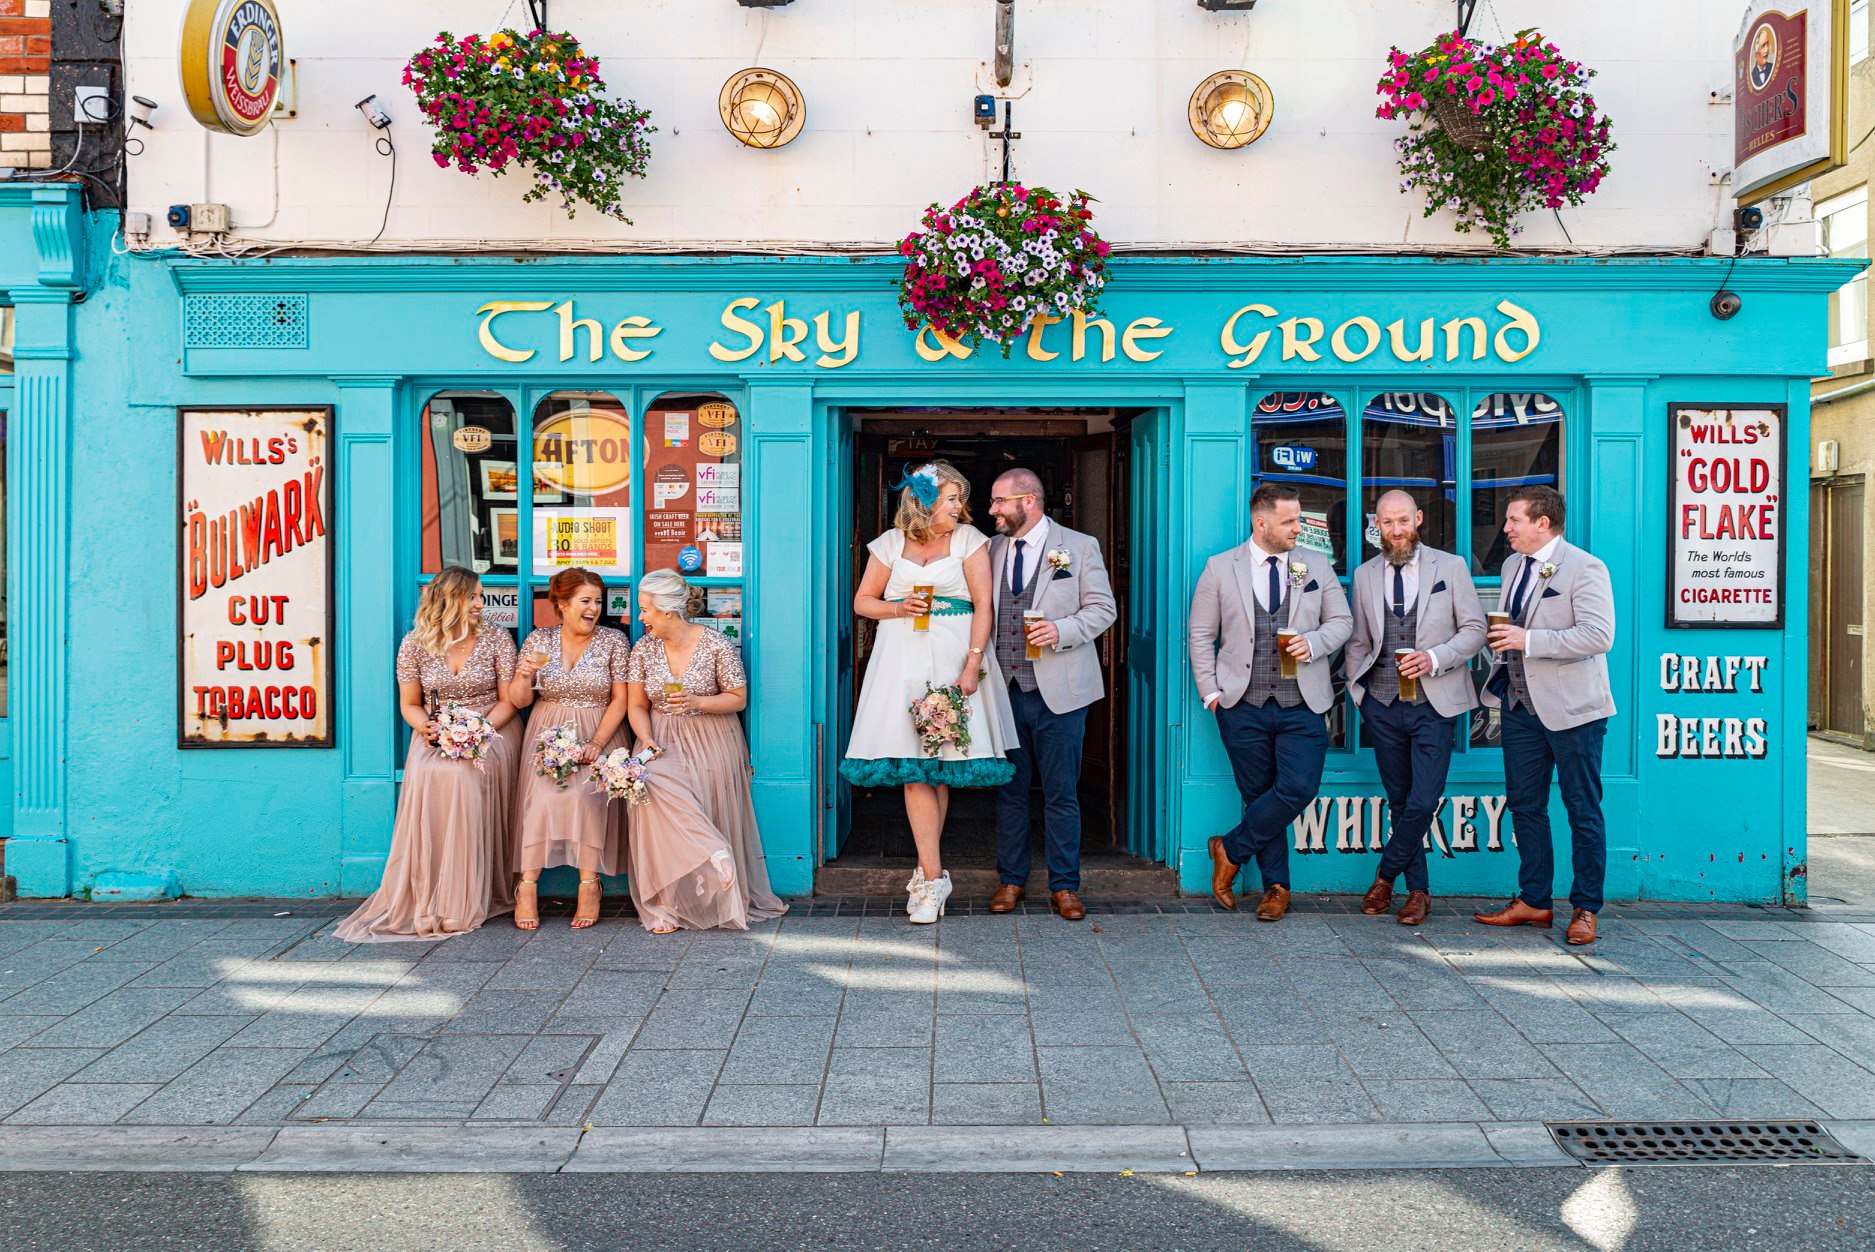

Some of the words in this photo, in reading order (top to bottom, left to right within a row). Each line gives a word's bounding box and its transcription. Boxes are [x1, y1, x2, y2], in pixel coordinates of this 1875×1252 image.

[230, 3, 279, 64] ERDINGER
[1749, 130, 1775, 151] HELLES
[476, 300, 663, 362] The
[708, 297, 860, 368] Sky
[1026, 307, 1174, 363] the
[463, 434, 481, 442] VFI
[708, 439, 726, 447] VFI
[698, 466, 715, 480] vfi
[698, 490, 715, 504] vfi
[551, 522, 580, 533] AUDIO
[583, 522, 612, 533] SHOOT
[551, 539, 571, 551] 30
[1688, 551, 1708, 562] The
[1713, 551, 1752, 562] World's
[1692, 571, 1721, 579] most
[1724, 567, 1765, 579] famous
[1681, 588, 1773, 604] CIGARETTE
[228, 595, 290, 626] CUT
[216, 640, 295, 671] PLUG
[1660, 653, 1769, 694] CRAFT
[193, 685, 317, 720] TOBACCO
[1656, 713, 1768, 760] BEERS
